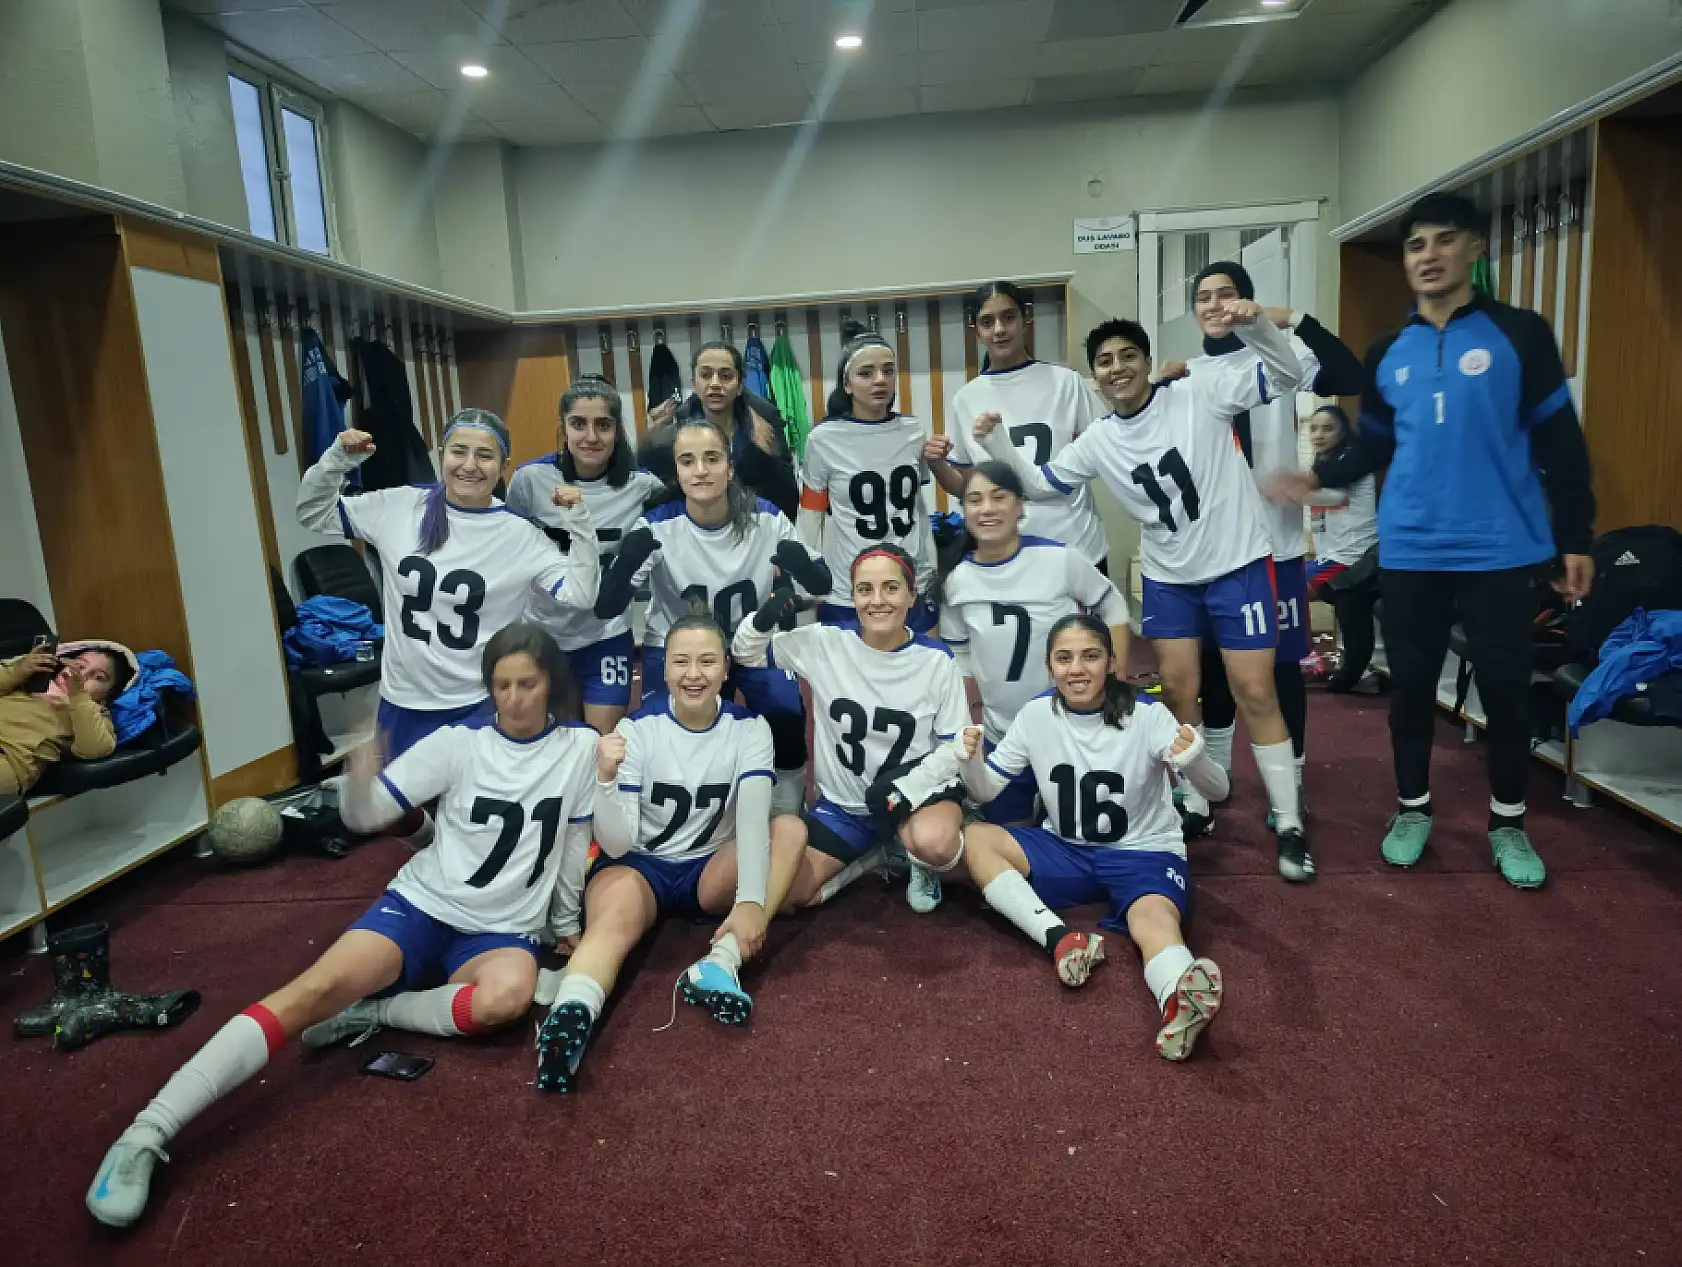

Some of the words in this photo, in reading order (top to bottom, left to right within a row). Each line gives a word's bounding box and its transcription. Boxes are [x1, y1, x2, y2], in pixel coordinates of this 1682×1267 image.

[1432, 391, 1445, 425] 1
[849, 465, 918, 540] 99
[1131, 446, 1200, 532] 11
[397, 555, 486, 650] 23
[1241, 602, 1267, 636] 11
[1277, 598, 1300, 631] 21
[600, 655, 629, 686] 65
[992, 602, 1031, 682] 7
[645, 782, 731, 851] 77
[1049, 763, 1129, 843] 16
[464, 796, 563, 888] 71
